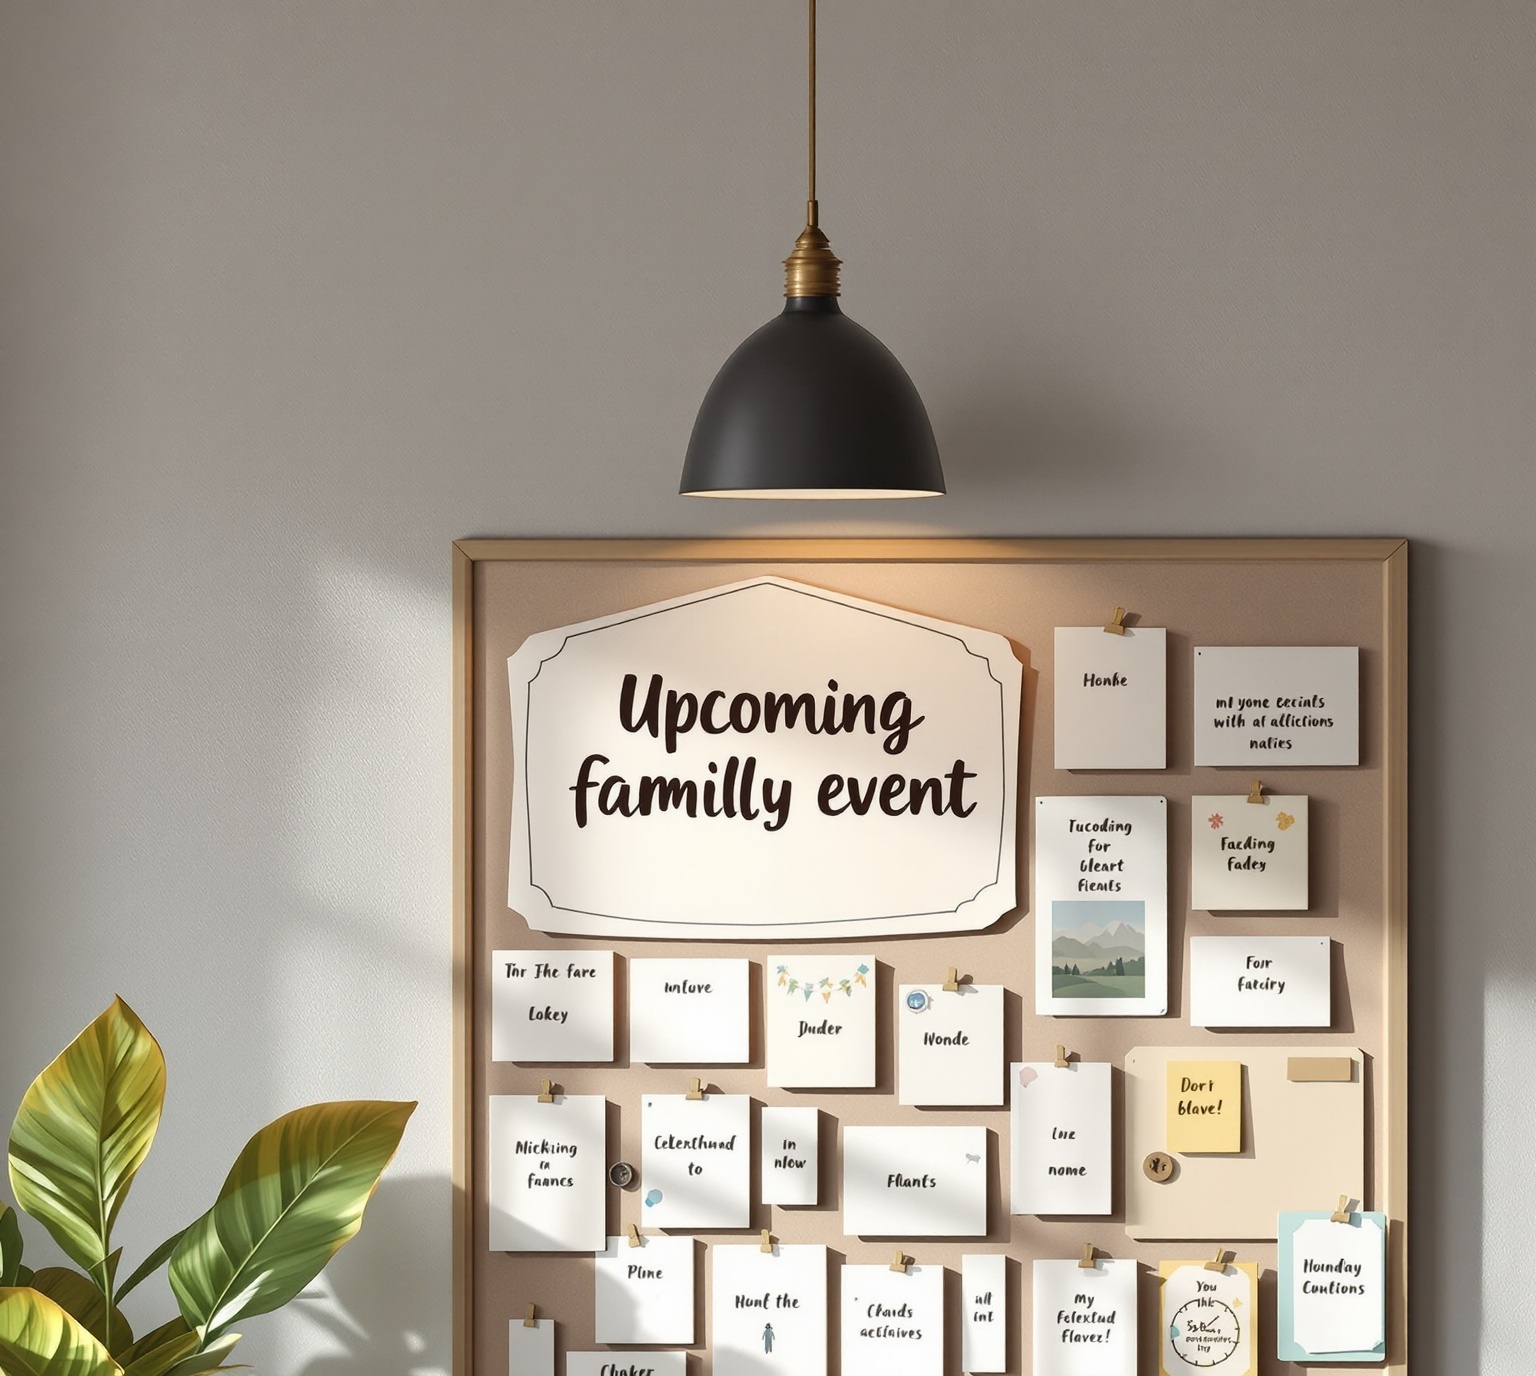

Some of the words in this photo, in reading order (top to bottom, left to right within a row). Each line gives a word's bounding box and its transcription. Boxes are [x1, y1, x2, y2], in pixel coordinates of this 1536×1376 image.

[619, 673, 926, 755] Upcoming
[817, 759, 978, 819] event
[687, 1162, 703, 1176] to
[775, 1292, 799, 1309] the
